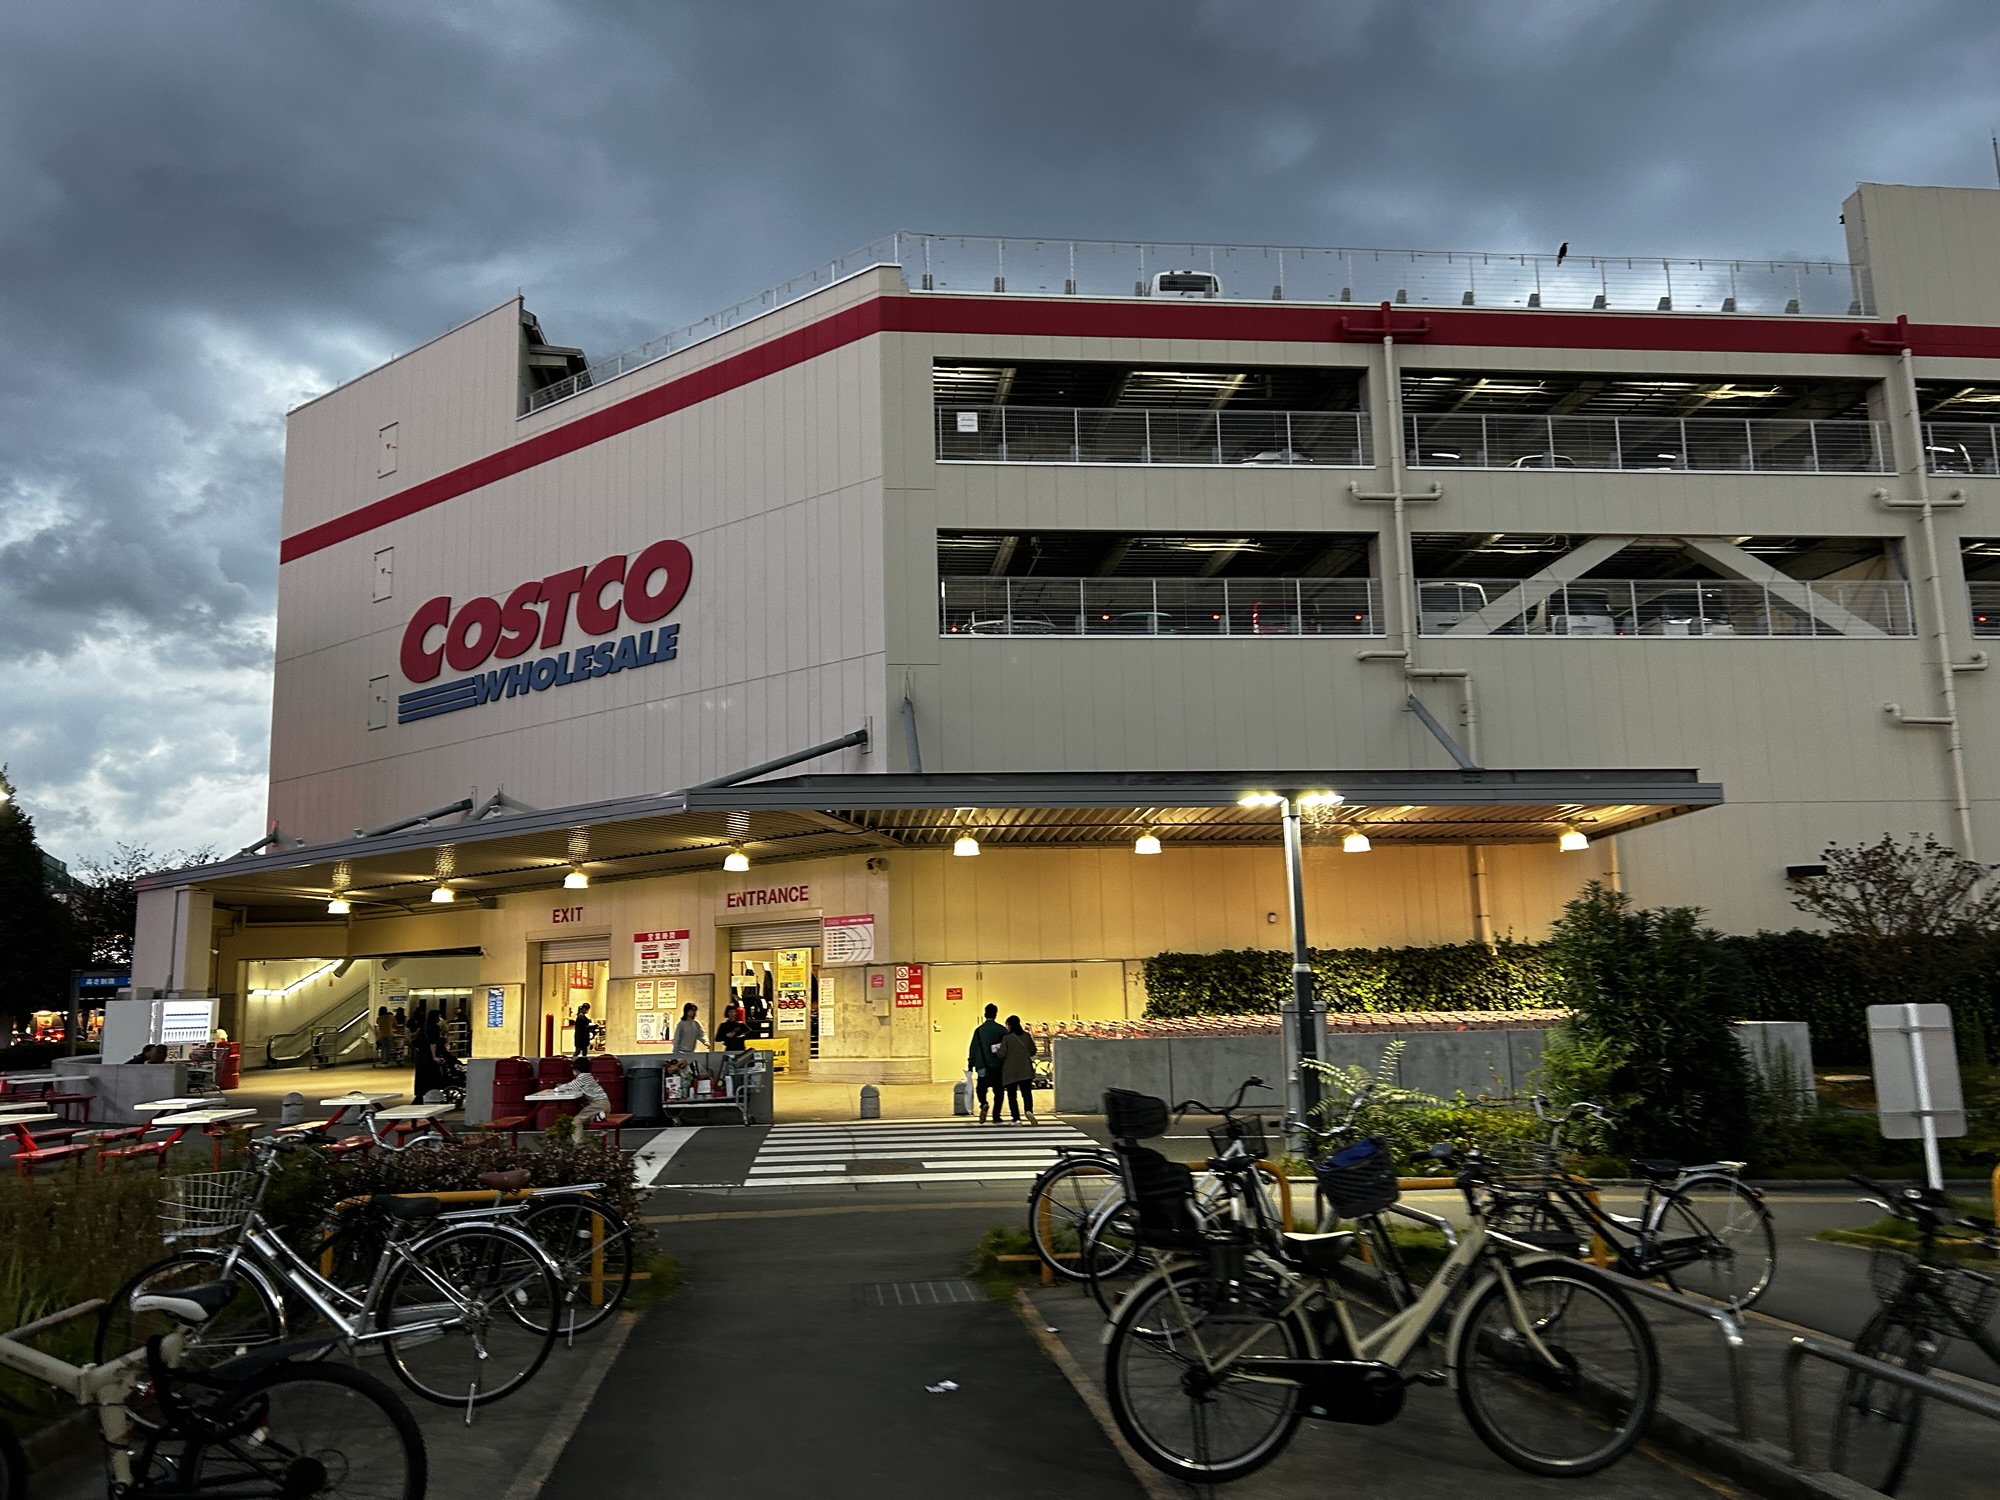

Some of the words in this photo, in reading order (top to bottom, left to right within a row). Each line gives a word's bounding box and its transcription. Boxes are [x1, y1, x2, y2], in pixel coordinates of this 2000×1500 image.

[401, 539, 692, 683] COSTCO
[474, 623, 680, 705] WHOLESALE
[552, 906, 583, 923] EXIT
[727, 885, 808, 908] ENTRANCE
